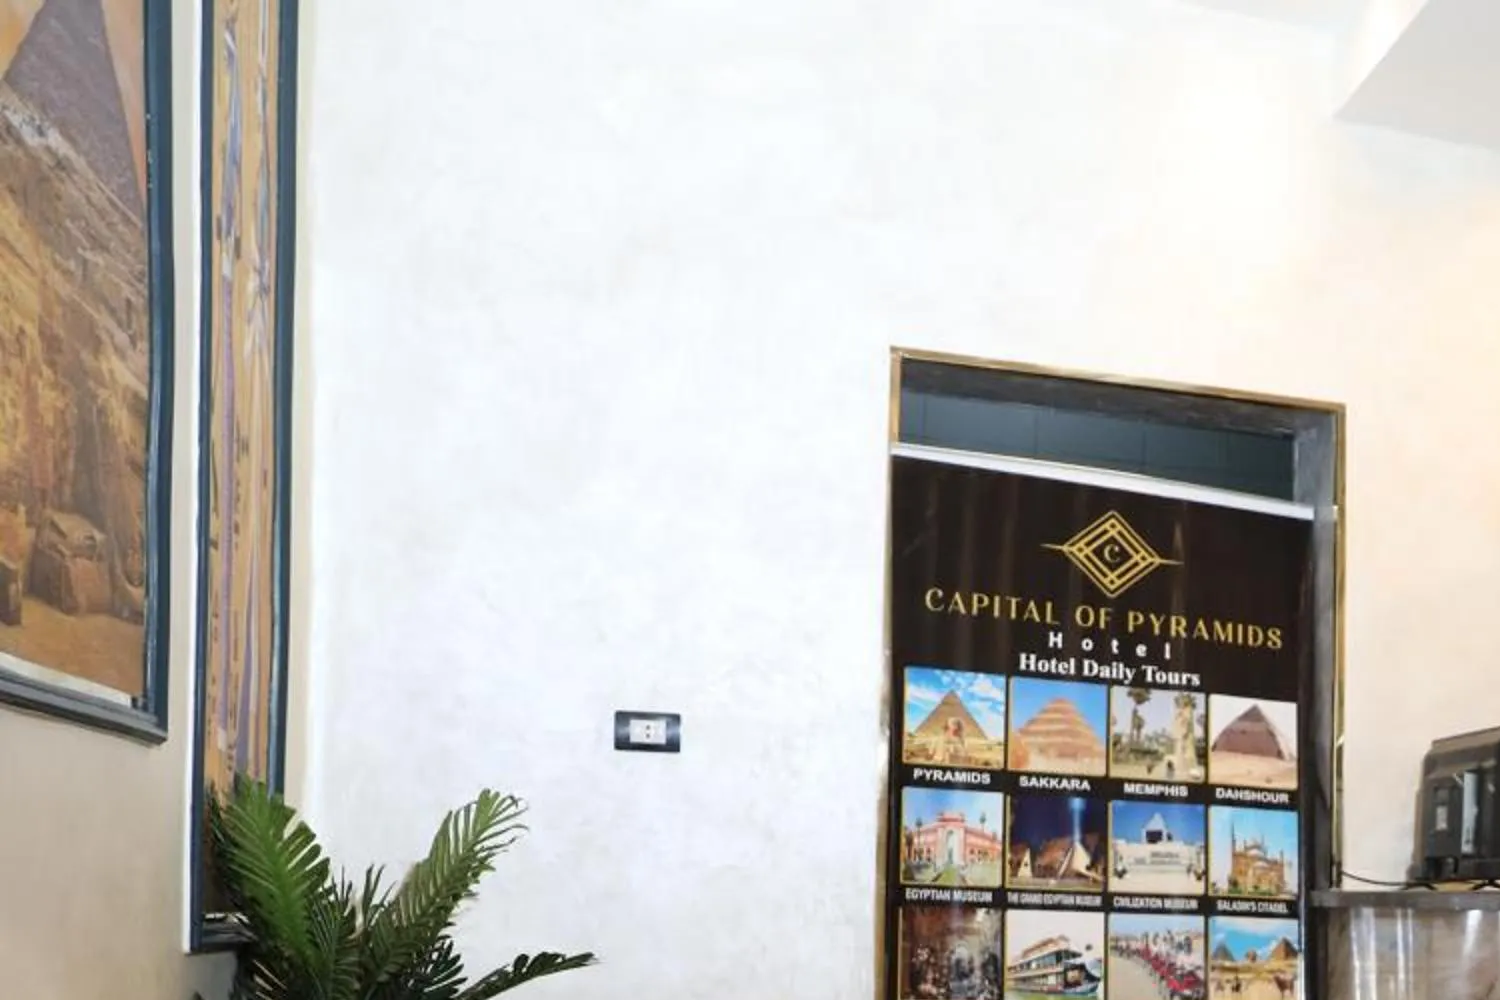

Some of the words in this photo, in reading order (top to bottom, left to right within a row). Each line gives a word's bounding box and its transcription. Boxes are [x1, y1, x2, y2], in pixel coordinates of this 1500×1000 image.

[925, 587, 1060, 626] CAPITAL
[1075, 605, 1113, 629] OF
[1128, 610, 1283, 650] PYRAMIDS
[1047, 631, 1172, 660] Hotel
[1019, 652, 1076, 676] Hotel
[1083, 658, 1137, 685] Daily
[1141, 664, 1201, 687] Tours
[913, 767, 991, 785] PYRAMIDS
[1019, 775, 1091, 792] SAKKARA
[1123, 782, 1189, 798] MEMPHIS
[905, 887, 951, 901] EGYPTIAN
[953, 888, 993, 903] MUSEUM
[1113, 896, 1163, 909] CIVILIZATION
